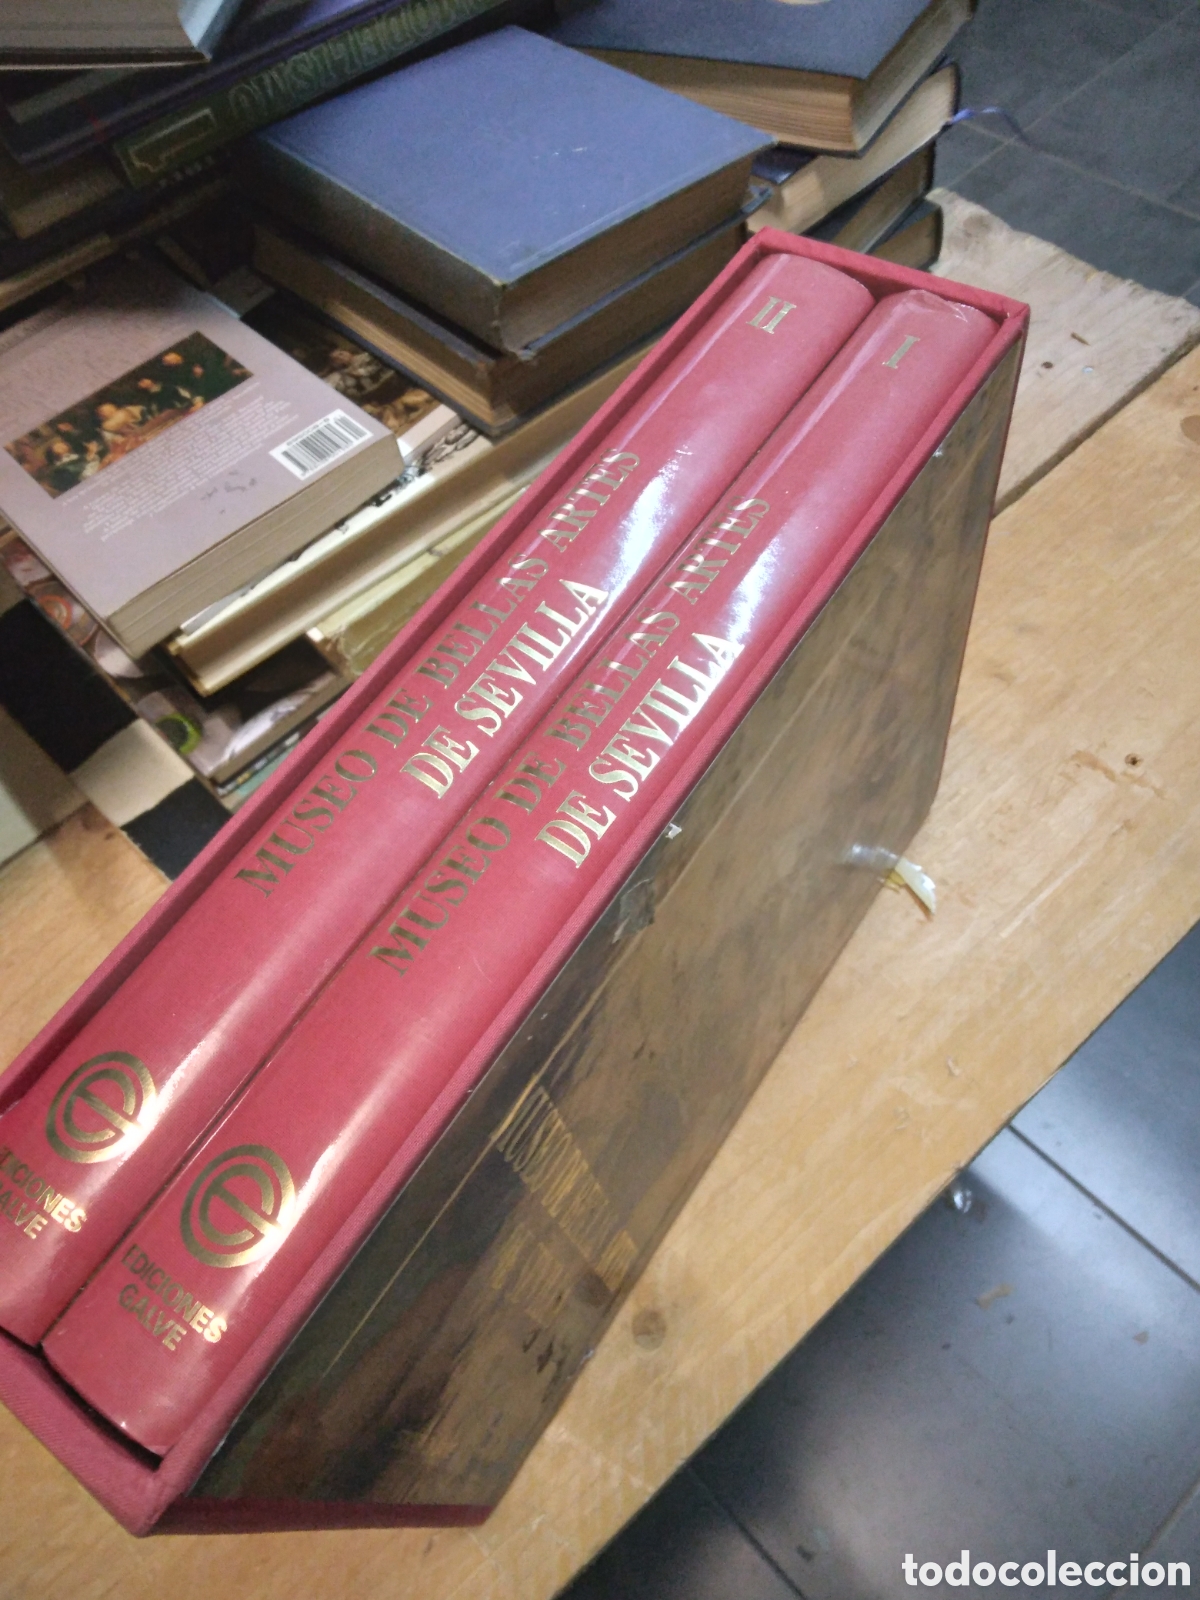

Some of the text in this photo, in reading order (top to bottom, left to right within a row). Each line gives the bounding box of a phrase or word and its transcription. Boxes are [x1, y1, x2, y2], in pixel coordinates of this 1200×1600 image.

[746, 296, 797, 334] II
[882, 334, 920, 369] I
[234, 448, 641, 898] MUSEO DE BELLAS ARTES
[400, 578, 609, 799] DE SEVILLA
[367, 494, 770, 977] MUSEO DE BELLAS ARTES
[534, 632, 744, 868] DE SEVILLA
[0, 1146, 87, 1233] DICIONES
[0, 1182, 48, 1240] ALVE
[118, 1283, 187, 1351] GALVE
[121, 1243, 228, 1343] EDICIONES
